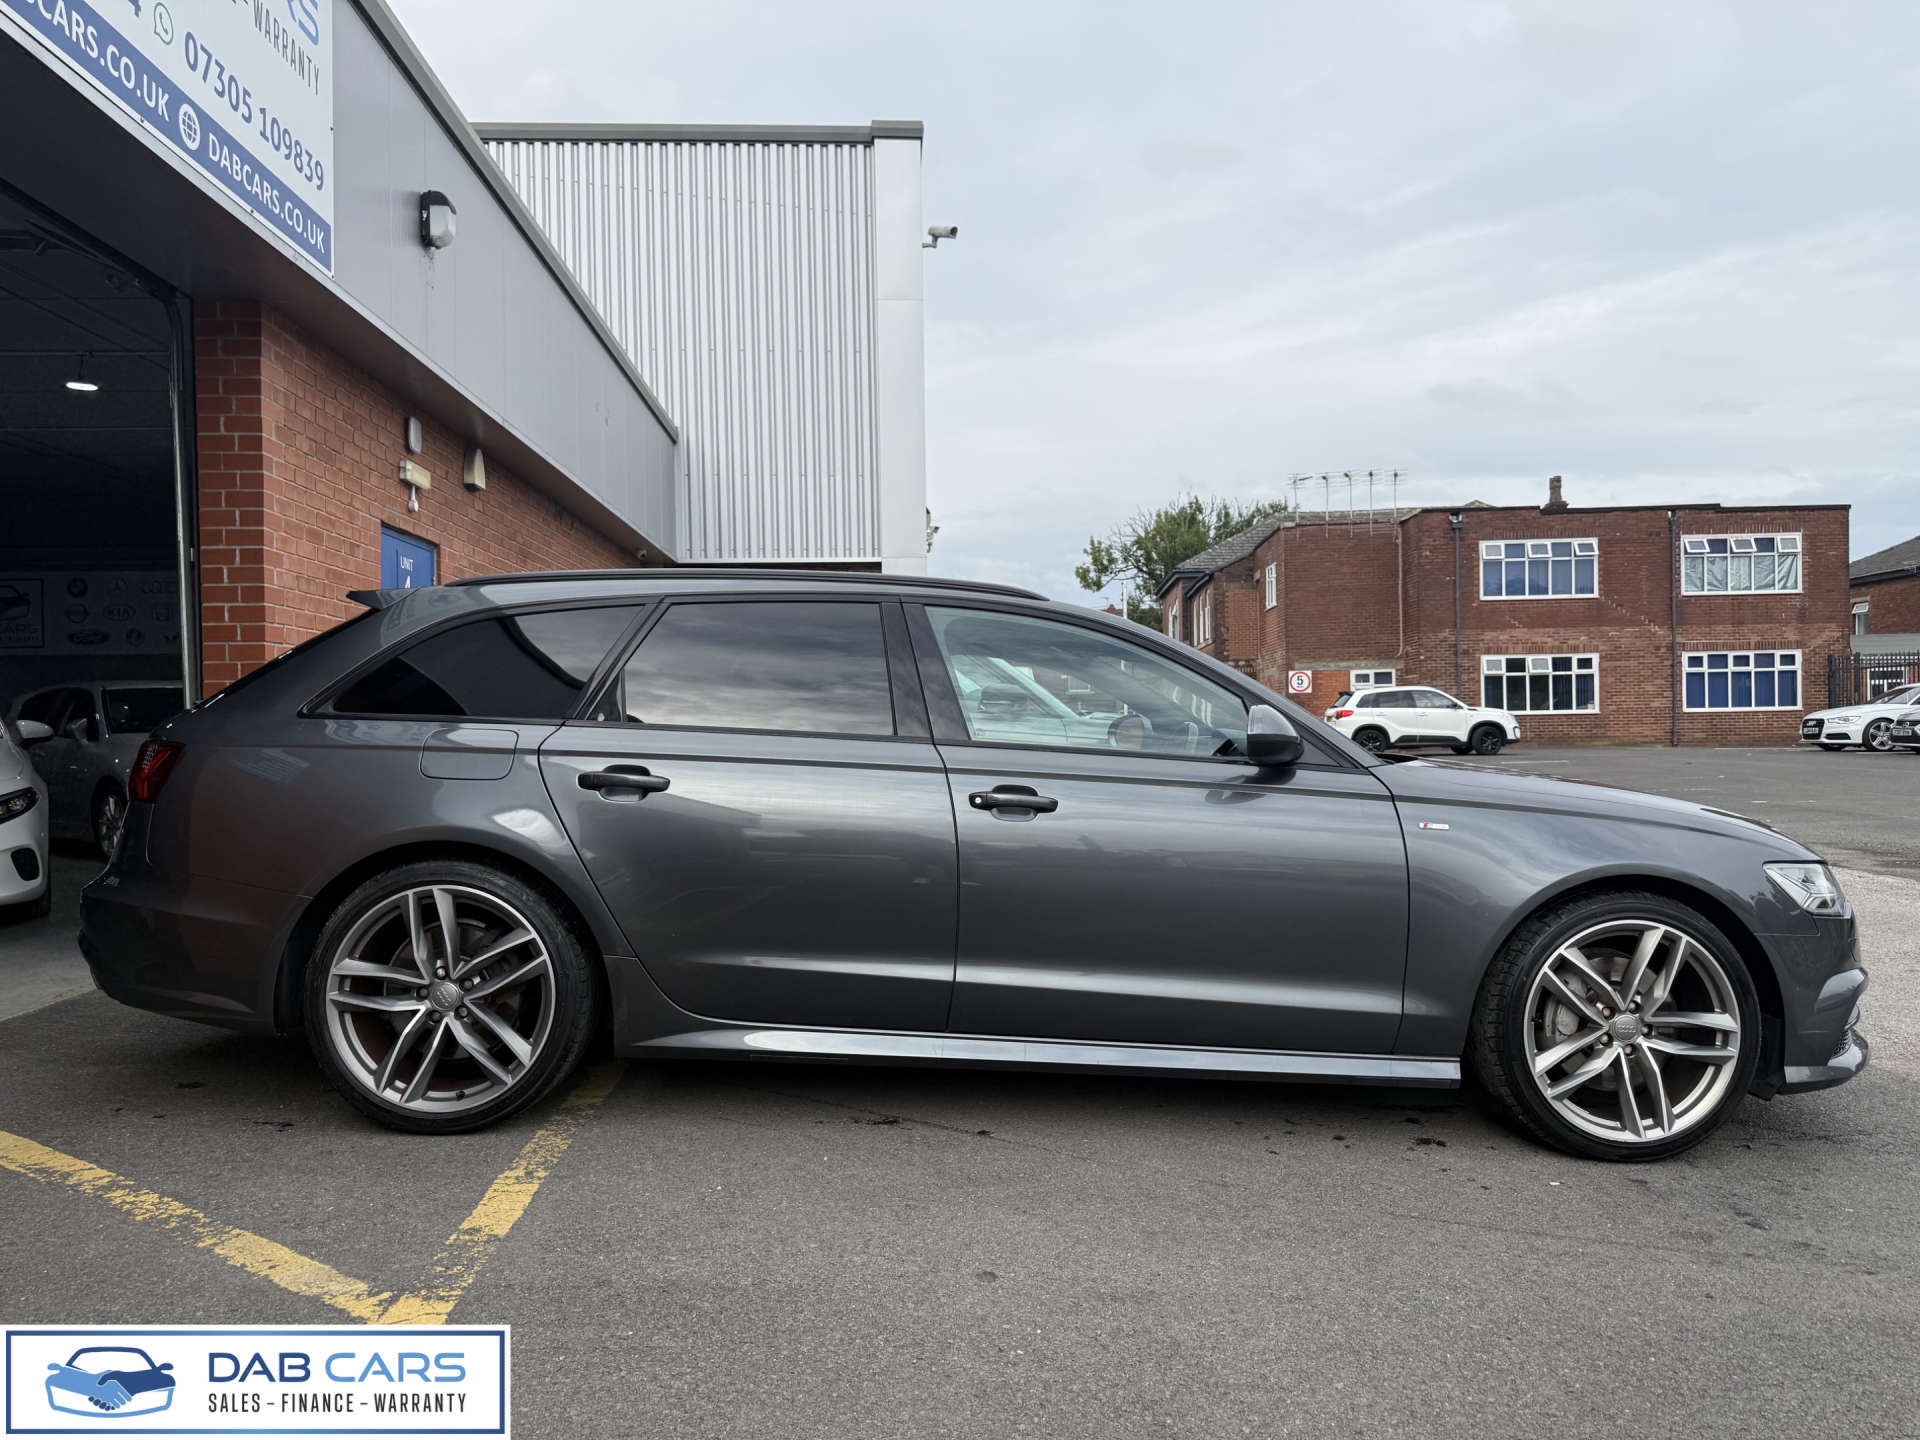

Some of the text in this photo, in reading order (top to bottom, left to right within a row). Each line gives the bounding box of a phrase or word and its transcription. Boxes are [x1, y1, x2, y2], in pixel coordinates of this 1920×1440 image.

[25, 0, 169, 121] CARS.CO.UK
[253, 0, 319, 96] WARRANTY
[184, 32, 324, 191] 07305 109839
[208, 132, 325, 253] DABCARS.CO.UK
[400, 554, 413, 571] UNIT
[1296, 675, 1304, 685] 5
